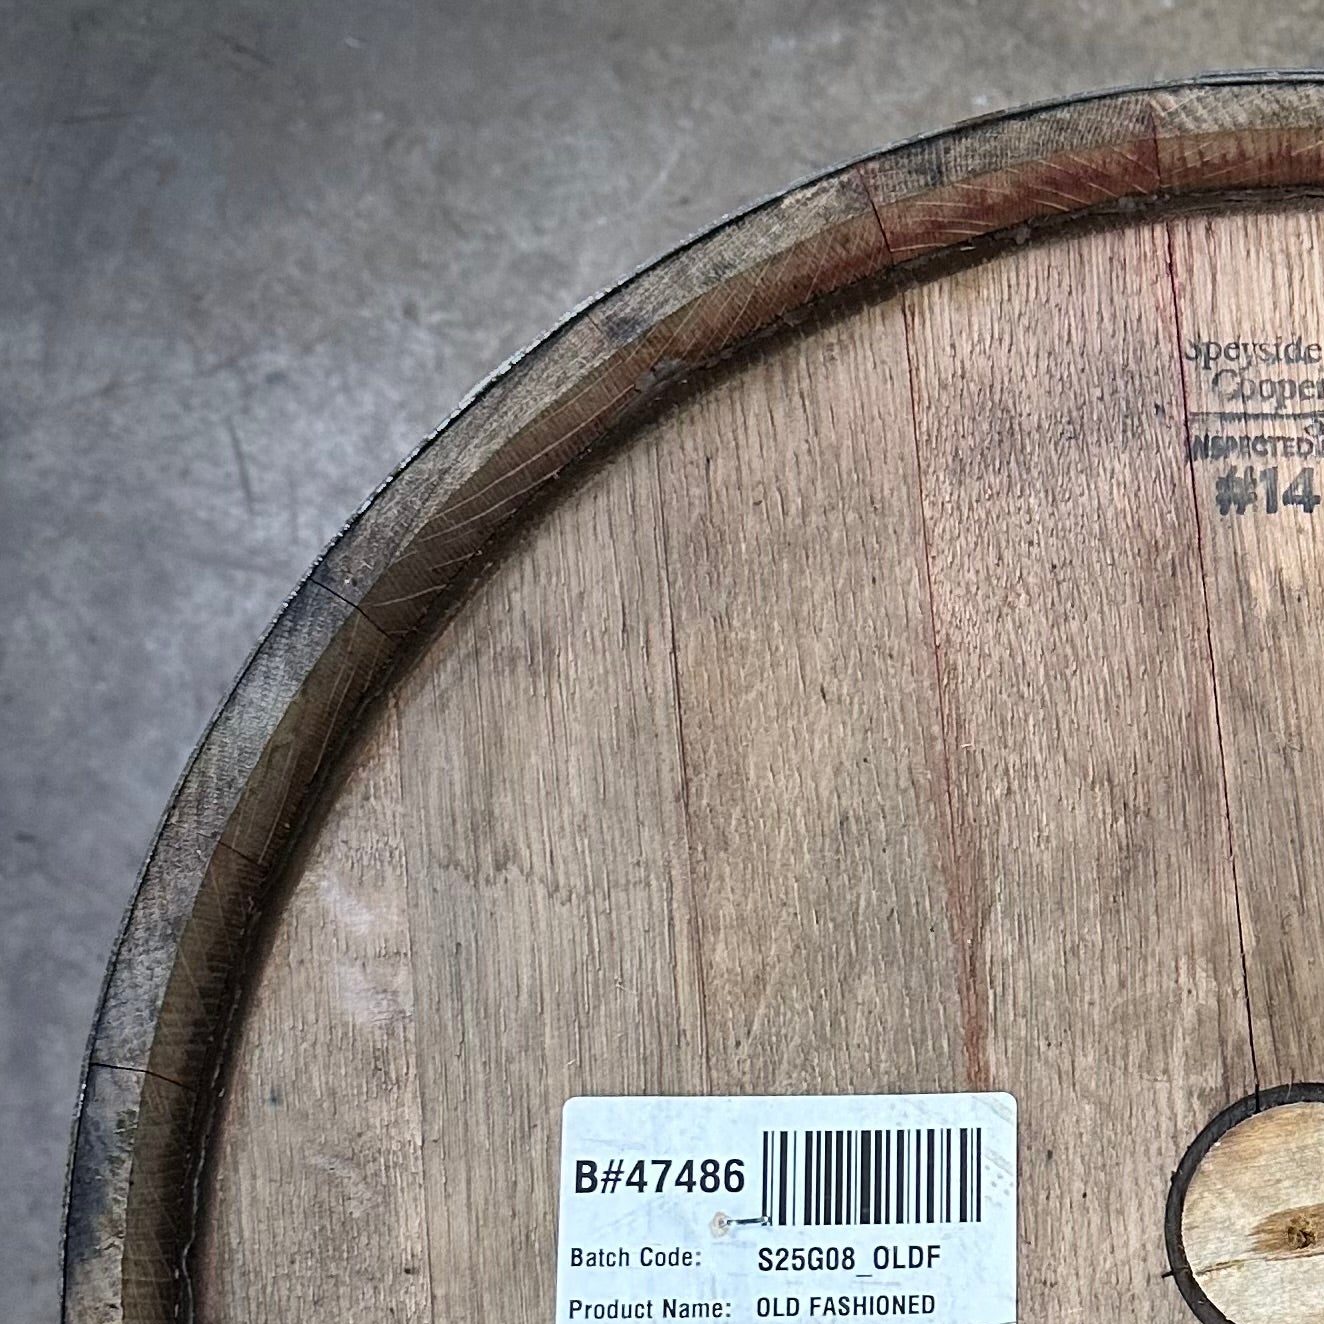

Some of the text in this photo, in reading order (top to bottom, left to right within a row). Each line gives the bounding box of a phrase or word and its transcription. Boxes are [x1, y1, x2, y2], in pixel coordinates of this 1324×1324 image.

[1184, 335, 1322, 369] Speyside
[1186, 432, 1314, 462] NSPECTED
[1215, 466, 1321, 515] #14
[575, 1158, 745, 1194] B#47486
[570, 1247, 630, 1267] Batch
[640, 1246, 701, 1267] Code:
[569, 1294, 935, 1320] Product Name: OLD FASHIONED
